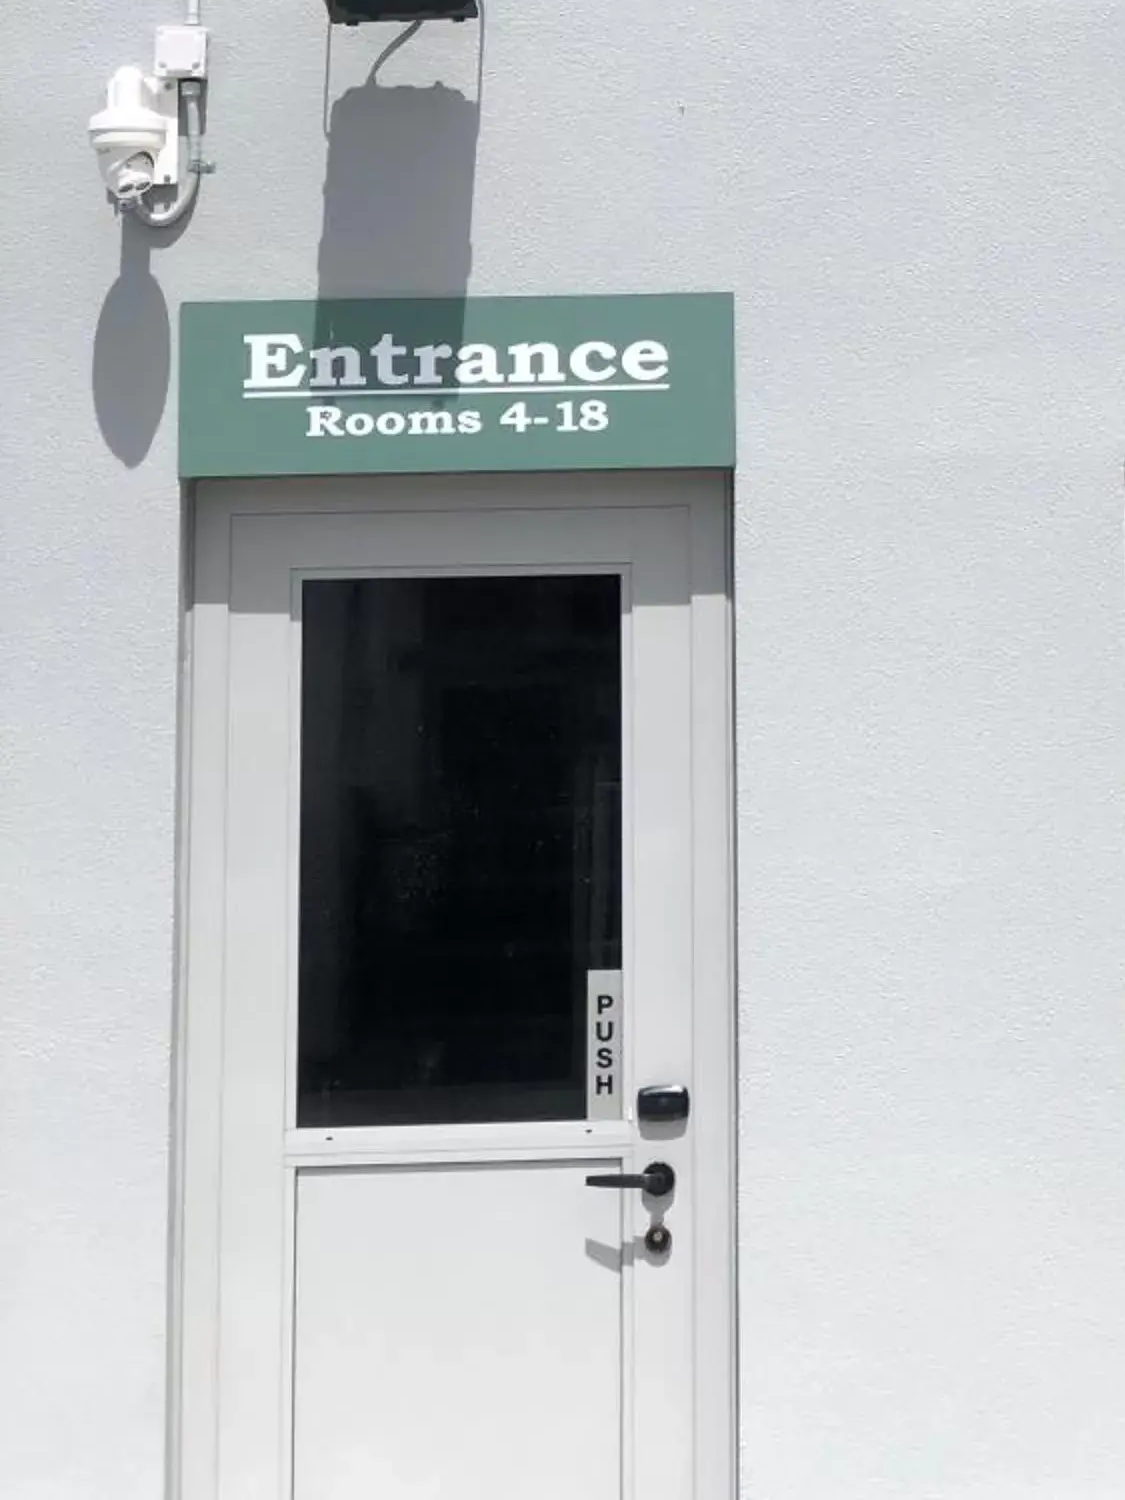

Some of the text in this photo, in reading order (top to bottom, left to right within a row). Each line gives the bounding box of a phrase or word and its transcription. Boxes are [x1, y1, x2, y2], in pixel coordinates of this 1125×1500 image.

[243, 332, 670, 389] Entrance
[306, 400, 609, 437] Rooms 4-18
[595, 994, 614, 1096] PUSH
